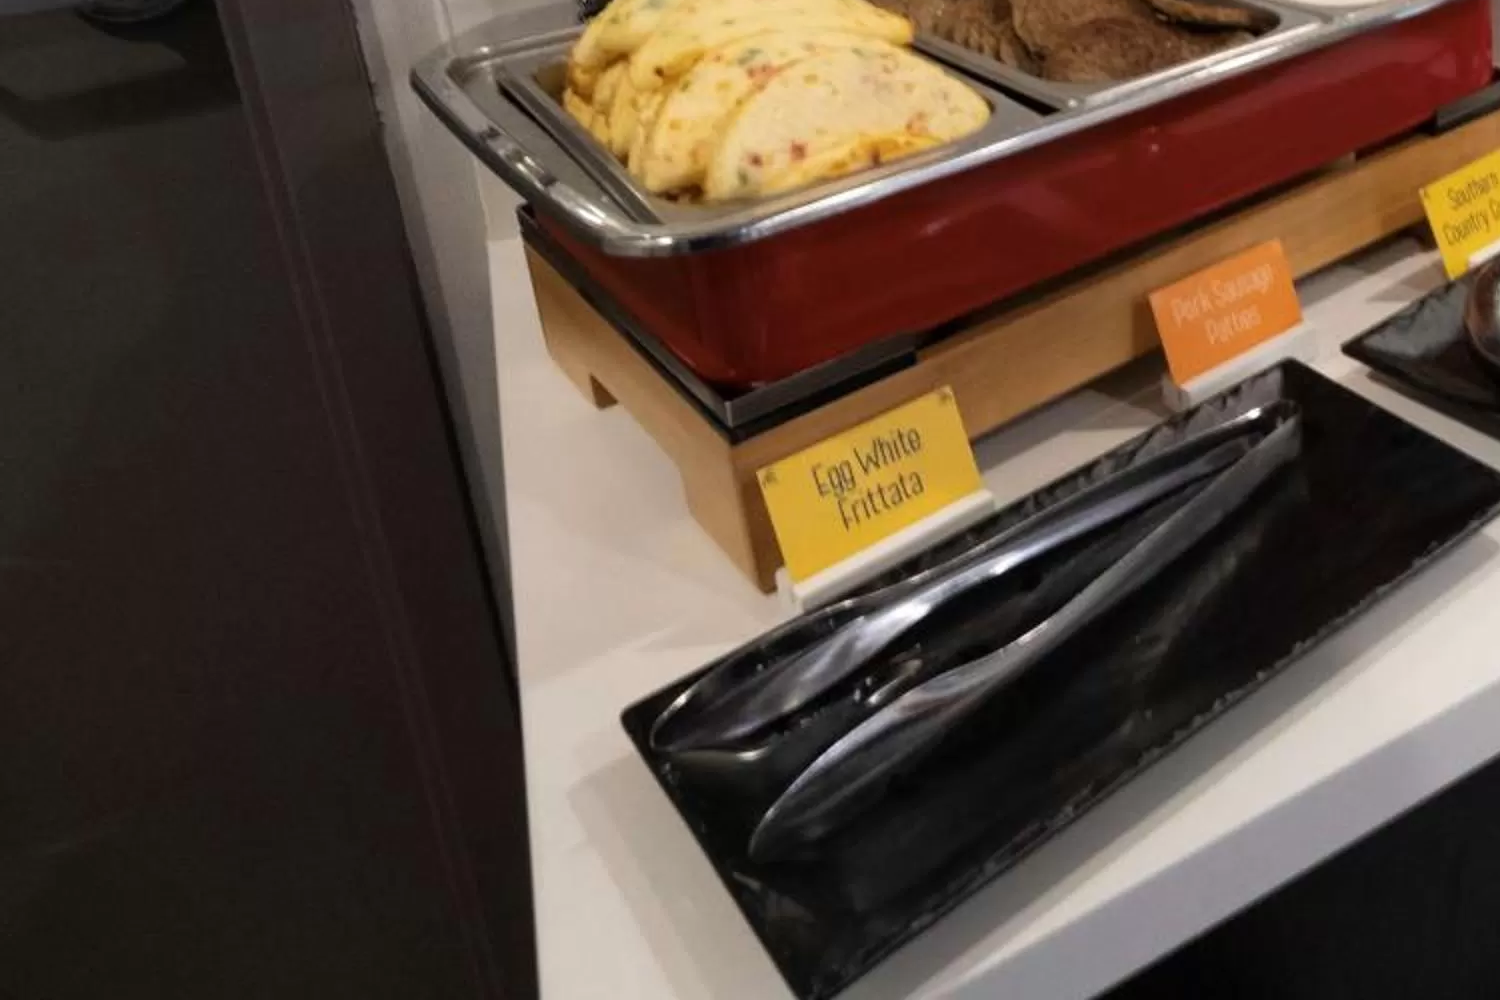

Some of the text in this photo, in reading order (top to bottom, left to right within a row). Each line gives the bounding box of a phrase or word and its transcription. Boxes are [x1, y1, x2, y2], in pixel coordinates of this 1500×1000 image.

[1442, 210, 1490, 246] Country
[1171, 290, 1213, 329] Pork
[811, 427, 921, 500] Egg White
[837, 470, 924, 533] Frittata
